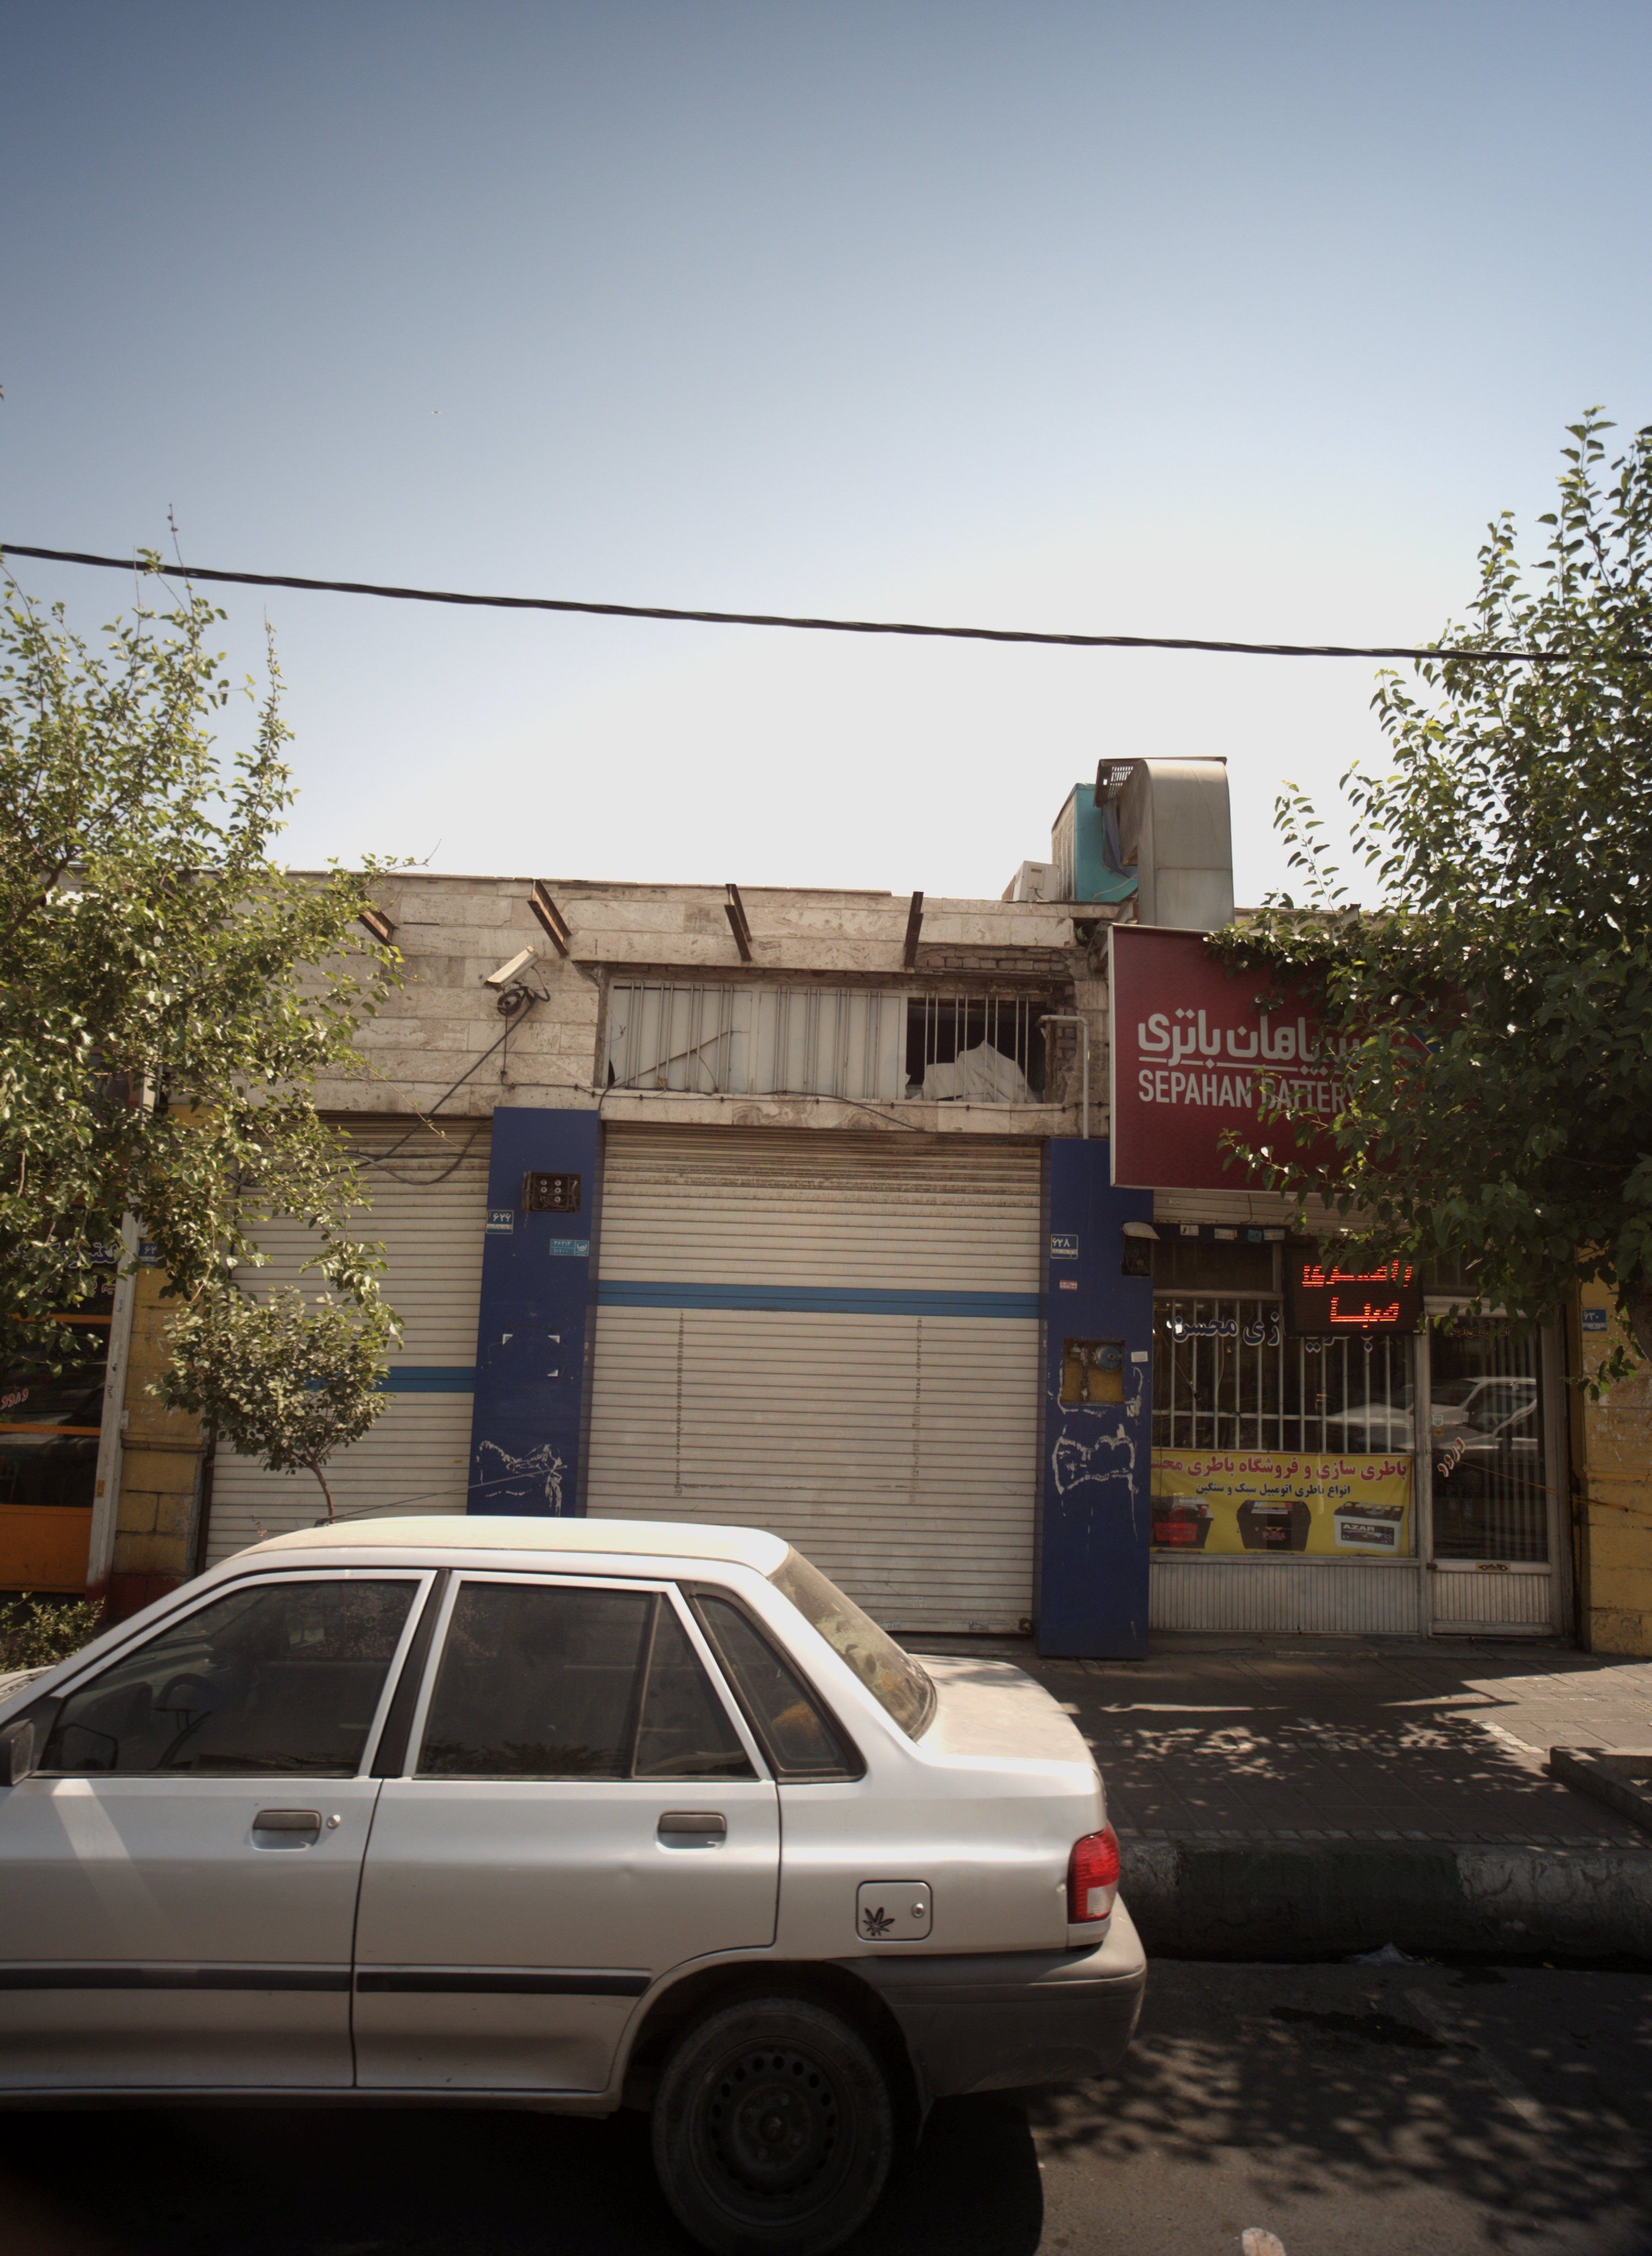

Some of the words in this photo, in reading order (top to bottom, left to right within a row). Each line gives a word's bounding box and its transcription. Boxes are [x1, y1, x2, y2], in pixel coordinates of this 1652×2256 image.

[1138, 1008, 1221, 1067] باتری
[1138, 1069, 1252, 1109] SEPAHAN
[1172, 1315, 1239, 1343] محسن
[1150, 1459, 1183, 1471] محس
[1187, 1456, 1235, 1477] باطری
[1239, 1457, 1298, 1479] فروشگاه
[1303, 1465, 1312, 1479] و
[1316, 1459, 1355, 1480] سازی
[1361, 1460, 1407, 1480] باطری
[1195, 1482, 1224, 1494] سنگین
[1227, 1485, 1232, 1495] و
[1235, 1483, 1256, 1494] سبک
[1259, 1484, 1292, 1496] اتومبیل
[1295, 1484, 1324, 1498] باطری
[1327, 1484, 1350, 1498] انواع
[1343, 1523, 1375, 1532] AZAR
